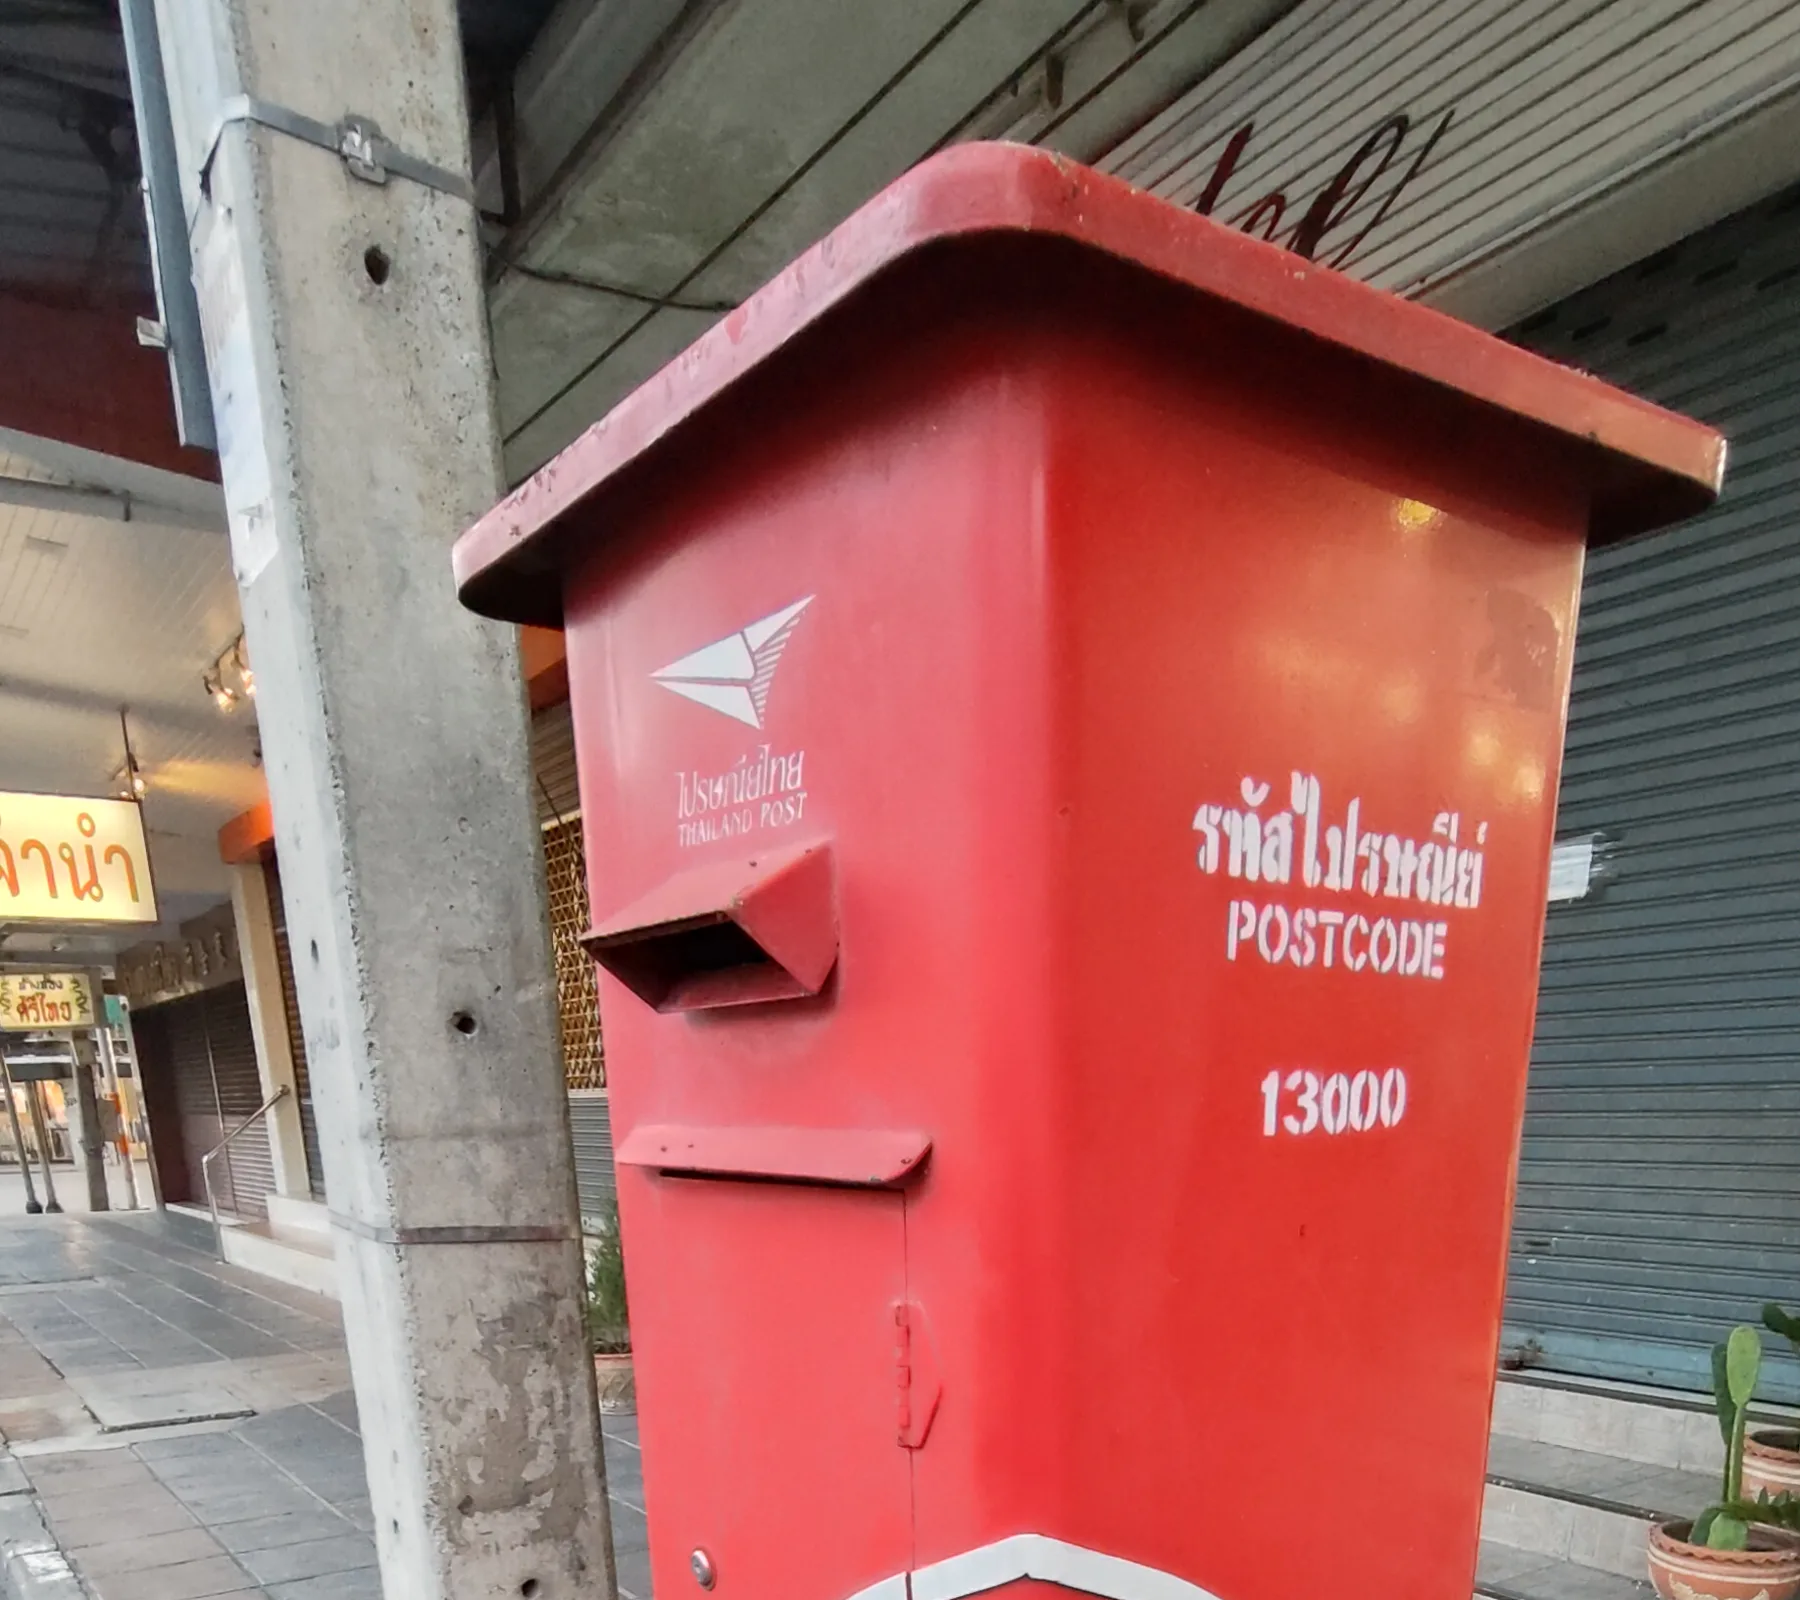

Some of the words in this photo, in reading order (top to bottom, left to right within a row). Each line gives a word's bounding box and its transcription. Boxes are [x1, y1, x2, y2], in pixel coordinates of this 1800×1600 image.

[674, 744, 805, 819] ไปรษณีย์ไทย
[678, 809, 753, 847] THAILAND
[760, 792, 808, 828] POST
[1192, 769, 1488, 909] รหัสไปรษณีย์
[1227, 900, 1448, 980] POSTCODE
[1260, 1068, 1407, 1137] 13000
